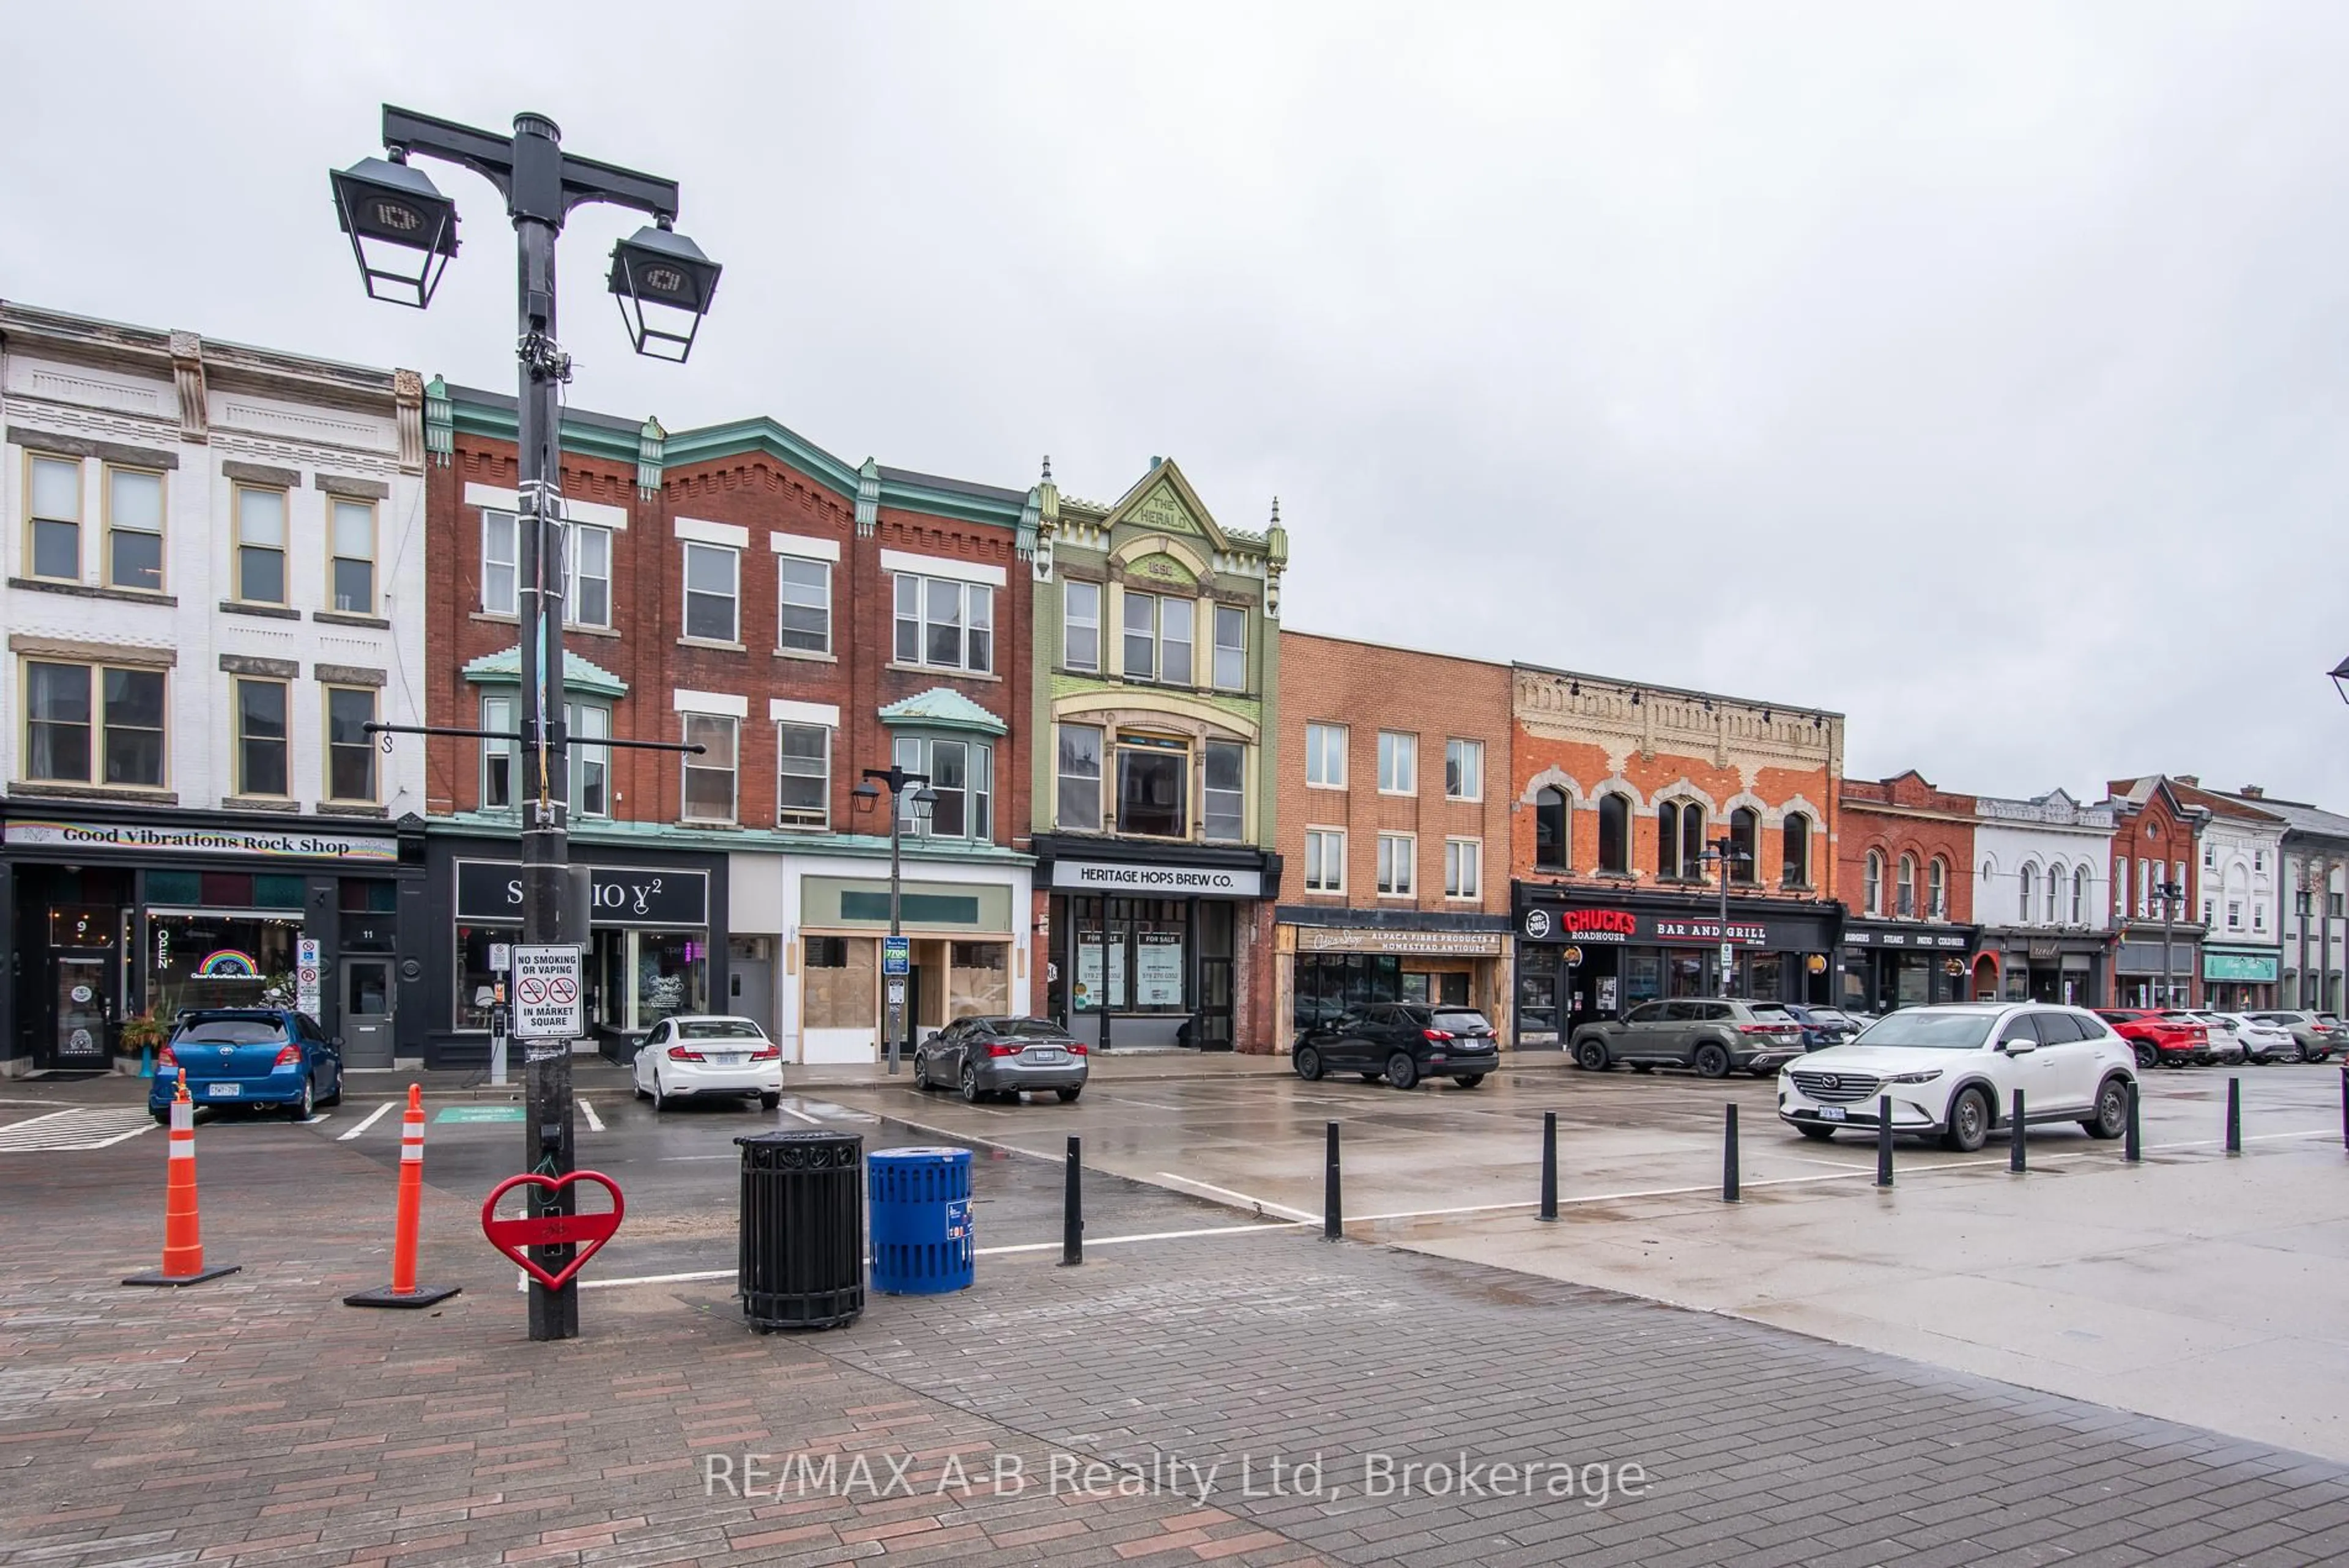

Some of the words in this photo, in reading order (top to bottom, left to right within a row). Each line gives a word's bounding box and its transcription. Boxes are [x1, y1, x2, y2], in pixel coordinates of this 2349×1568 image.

[1152, 497, 1174, 511] THE
[1140, 508, 1186, 529] HERALD
[63, 828, 119, 843] Good
[125, 830, 239, 848] Vibrations
[244, 837, 294, 851] Rock
[300, 838, 349, 856] Shop
[1081, 868, 1138, 883] HERITAGE
[1140, 871, 1174, 885] HOPS
[1176, 873, 1211, 886] BREW
[1213, 875, 1234, 887] CO.
[507, 880, 625, 907] SIO
[77, 921, 87, 932] 9
[1657, 923, 1685, 934] BAR
[1692, 926, 1720, 936] AND
[1726, 927, 1765, 938] GRILL
[363, 930, 373, 939] 11
[1572, 931, 1625, 942] ROADHOUSE
[1844, 933, 1869, 942] BURGERS
[1883, 934, 1904, 944] STEAKS
[1917, 936, 1932, 945] PATIO
[158, 929, 169, 969] OPEN
[518, 955, 530, 964] NO
[533, 955, 576, 964] SMOKING
[538, 966, 572, 974] VAPING
[536, 1007, 574, 1016] MARKET
[531, 1018, 567, 1027] SQUARE
